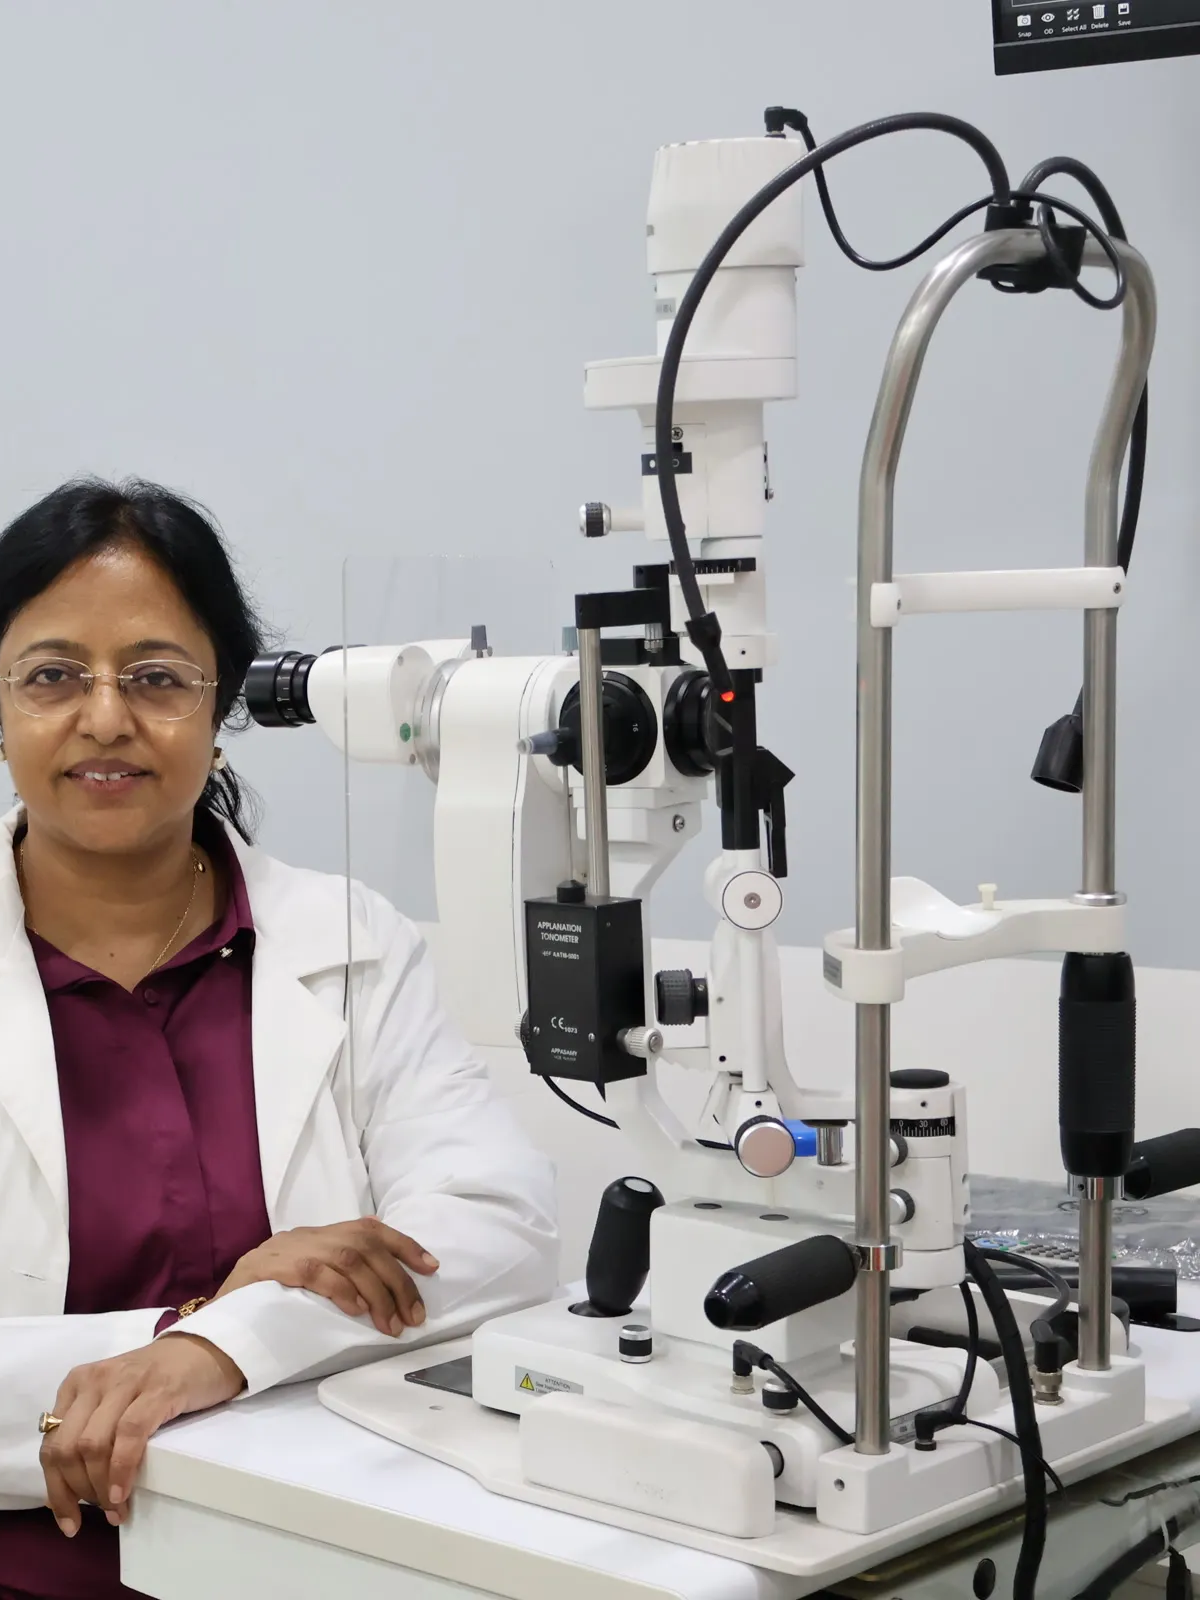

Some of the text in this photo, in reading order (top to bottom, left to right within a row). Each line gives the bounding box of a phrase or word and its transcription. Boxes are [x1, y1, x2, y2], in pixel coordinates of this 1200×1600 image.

[1091, 22, 1109, 30] Delete
[537, 921, 582, 933] APPLANATION
[541, 932, 579, 944] TONOMETER
[919, 1120, 929, 1128] 30
